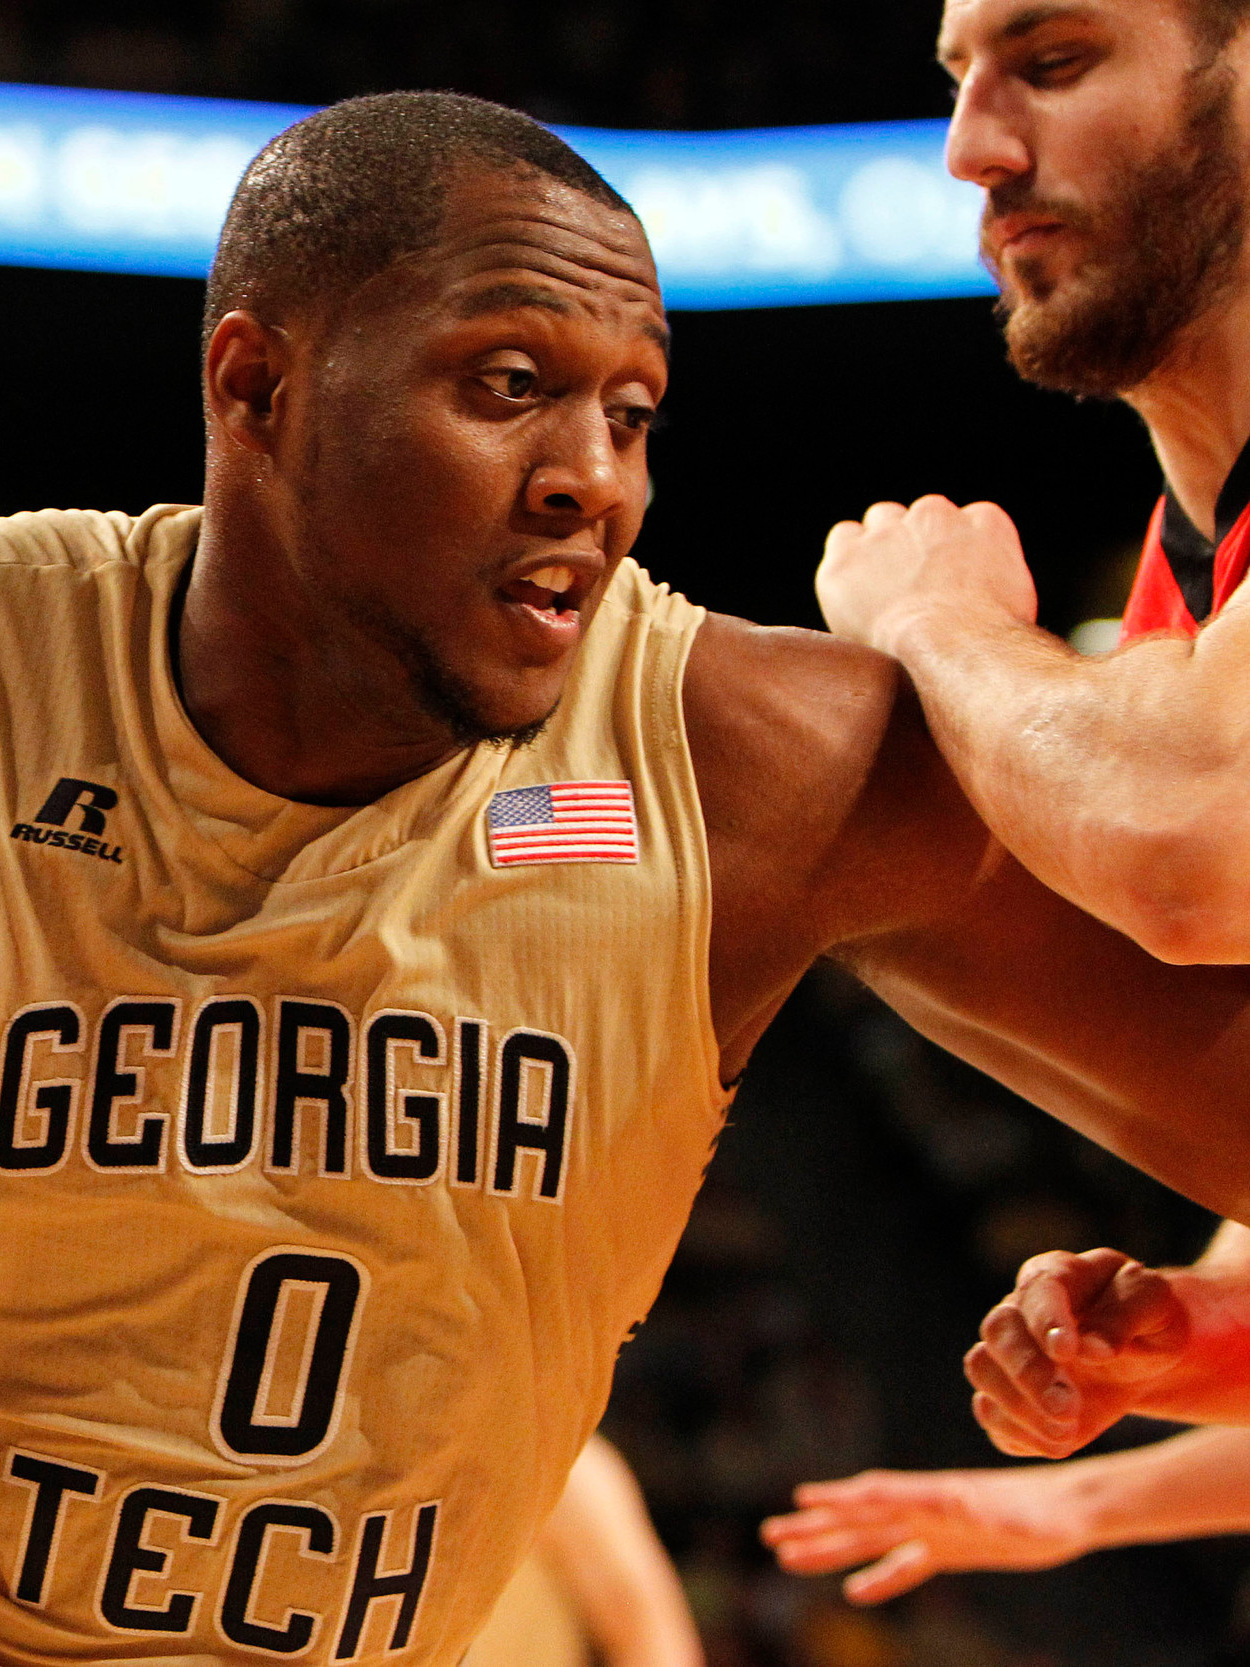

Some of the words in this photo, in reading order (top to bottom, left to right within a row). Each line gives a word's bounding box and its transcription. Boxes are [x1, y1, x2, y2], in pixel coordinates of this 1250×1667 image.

[10, 823, 123, 865] RUSSELL
[209, 1244, 372, 1466] 0
[2, 1446, 444, 1666] TECH
